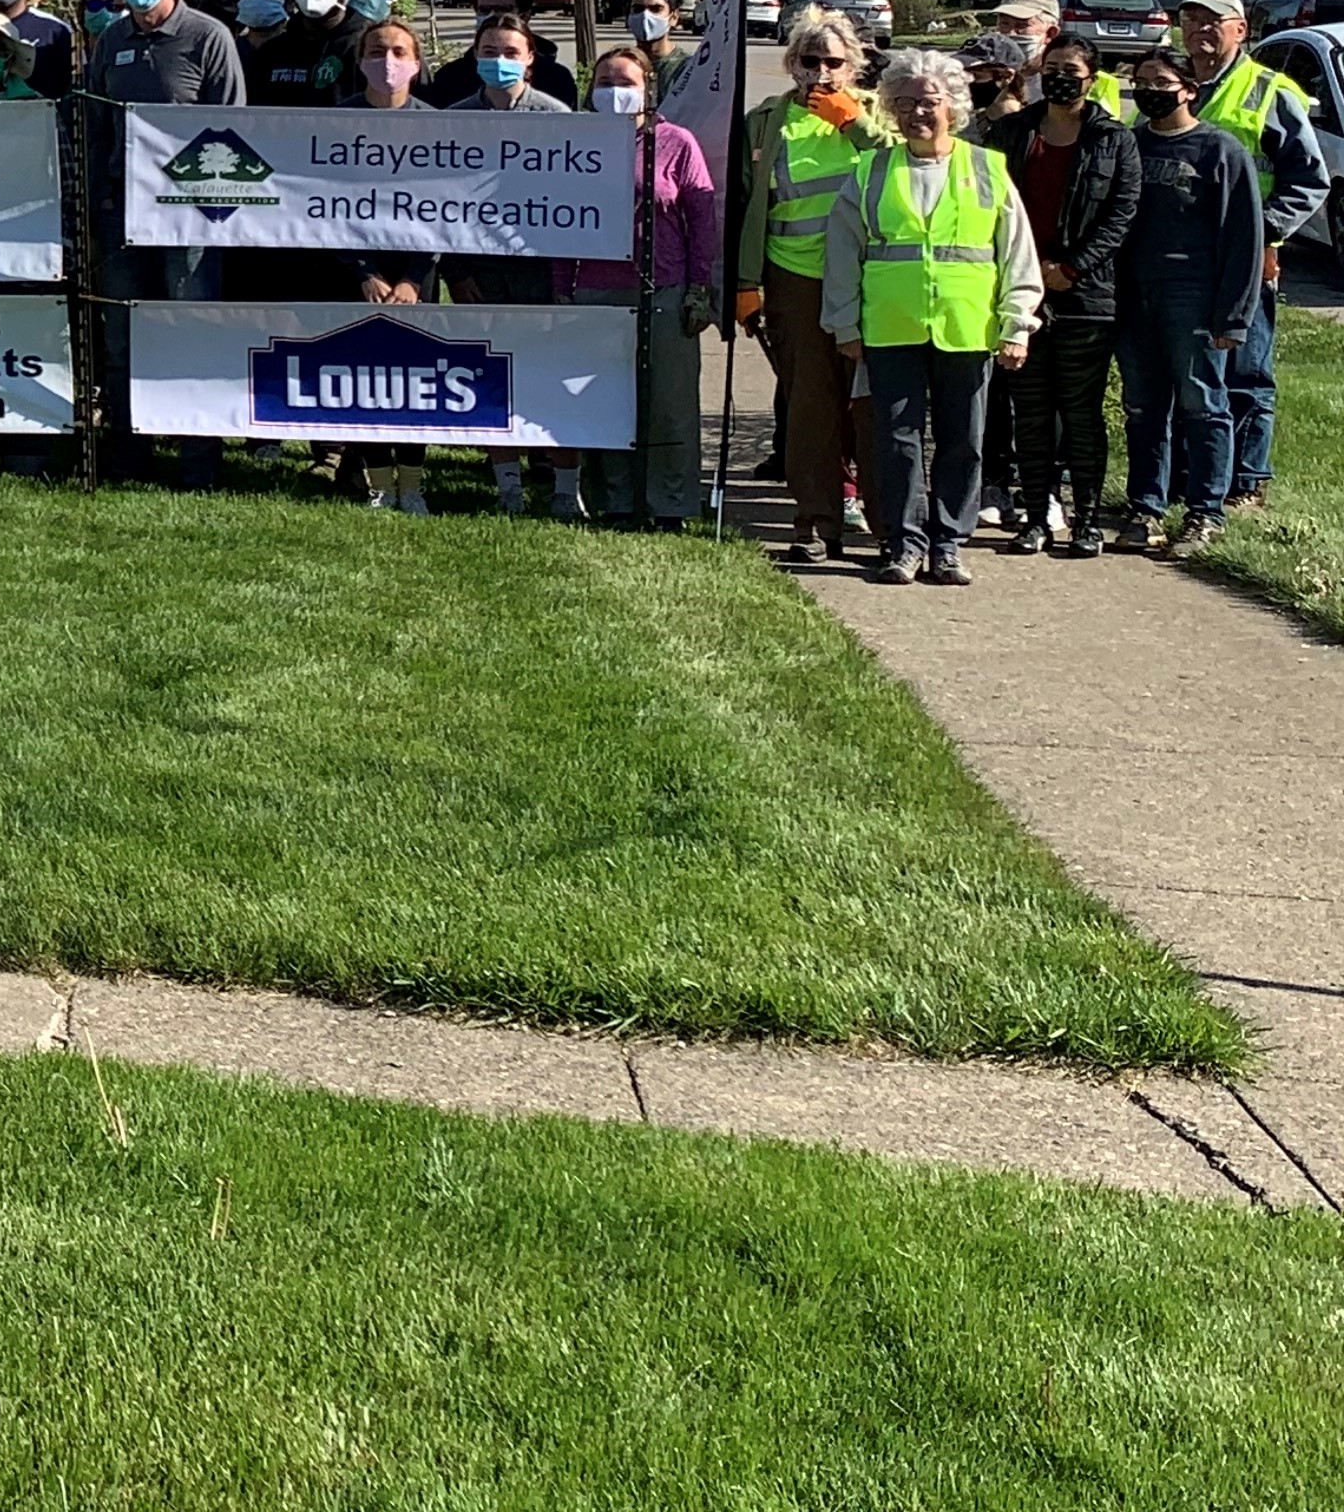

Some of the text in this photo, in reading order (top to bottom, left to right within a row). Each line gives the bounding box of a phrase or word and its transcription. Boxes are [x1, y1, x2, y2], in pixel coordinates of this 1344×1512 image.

[311, 135, 603, 175] Lafayette Parks
[307, 189, 601, 230] and Recreation
[286, 354, 478, 414] LOWE'S
